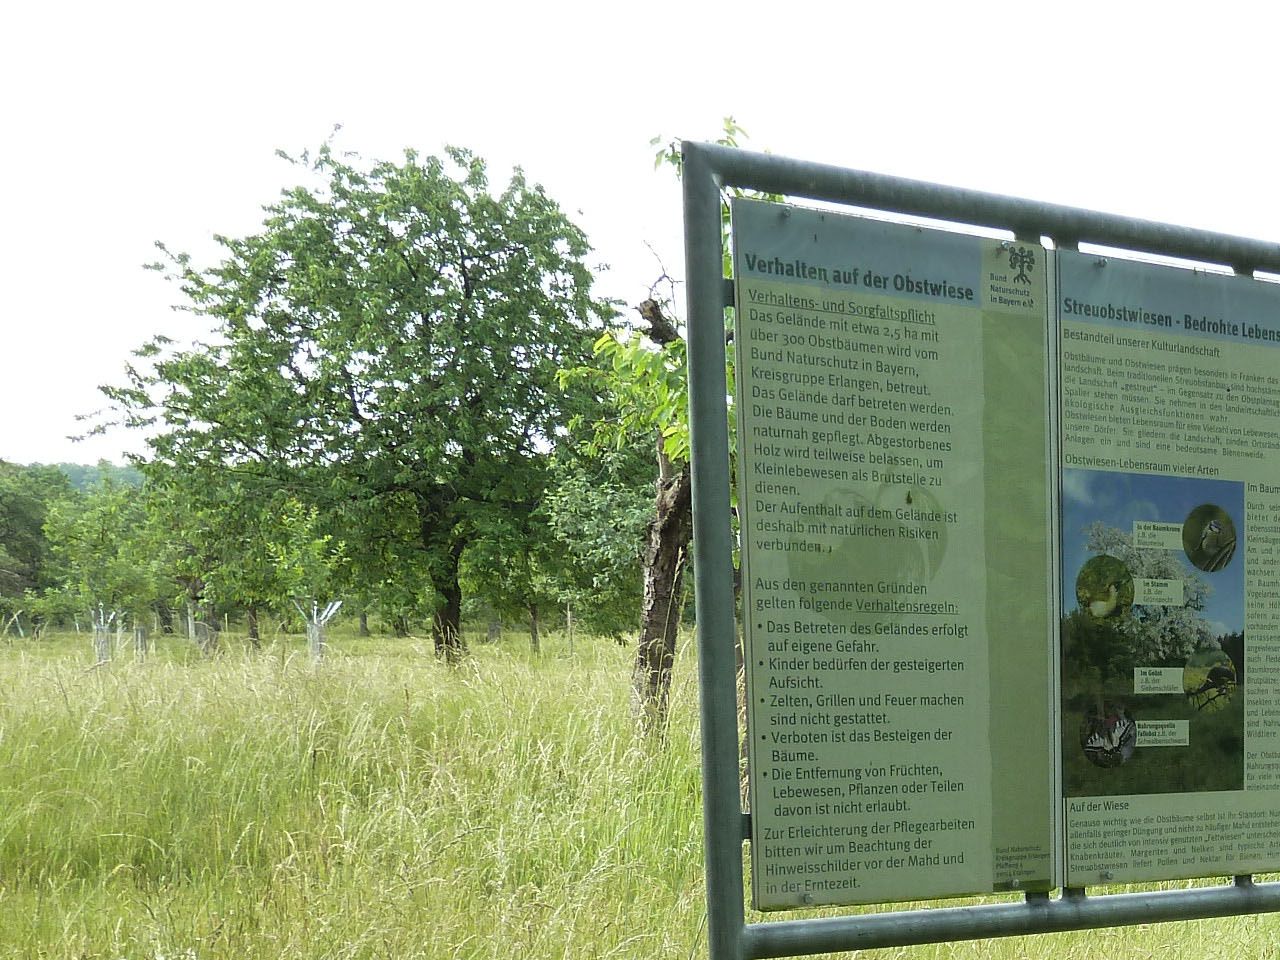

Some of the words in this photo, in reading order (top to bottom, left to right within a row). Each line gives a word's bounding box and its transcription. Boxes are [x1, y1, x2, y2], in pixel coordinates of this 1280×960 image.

[745, 254, 829, 282] Verhalten
[833, 268, 859, 285] auf
[863, 270, 889, 289] der
[893, 275, 974, 300] Obstwiese
[748, 289, 819, 311] Verhaltens-
[822, 300, 845, 314] und
[848, 302, 935, 325] Sorgfaltspflicht
[1064, 298, 1172, 326] Streuobstwiesen
[1184, 315, 1239, 336] Bedrohte
[749, 308, 773, 323] Das
[776, 312, 826, 329] Gelände
[829, 318, 848, 332] mit
[851, 322, 879, 335] etwa
[902, 326, 918, 340] ha
[921, 330, 939, 343] mit
[750, 328, 779, 342] über
[782, 334, 805, 346] 300
[808, 335, 884, 353] Obstbäumen
[886, 344, 911, 357] wird
[914, 349, 938, 360] vom
[1064, 329, 1114, 344] Bestandteil
[1116, 337, 1150, 348] unserer
[1151, 340, 1220, 357] Kulturlandschaft
[751, 347, 783, 362] Bund
[787, 351, 859, 370] Naturschutz
[862, 358, 872, 372] in
[876, 360, 919, 378] Bayern,
[751, 367, 825, 386] Kreisgruppe
[828, 374, 883, 392] Erlangen,
[886, 380, 931, 395] betreut.
[752, 385, 775, 399] Das
[778, 388, 828, 404] Gelände
[831, 393, 856, 407] darf
[858, 395, 907, 411] betreten
[753, 404, 773, 418] Die
[776, 407, 818, 422] Bäume
[822, 412, 844, 424] und
[848, 413, 867, 426] der
[870, 415, 906, 429] Boden
[909, 420, 951, 433] werden
[753, 426, 808, 440] naturnah
[867, 433, 952, 451] Abgestorbenes
[754, 443, 781, 457] Holz
[783, 446, 810, 459] wird
[813, 448, 865, 463] teilweise
[869, 452, 923, 468] belassen,
[926, 459, 943, 469] um
[1065, 454, 1171, 471] Obstwiesen-Lebensraum
[1172, 463, 1196, 474] vieler
[1197, 465, 1219, 476] Arten
[754, 462, 850, 480] Kleinlebewesen
[852, 469, 868, 481] als
[872, 470, 926, 486] Brutstelle
[929, 477, 942, 486] zu
[755, 481, 800, 495] dienen.
[1248, 480, 1258, 492] Im
[756, 500, 777, 513] Der
[780, 502, 842, 517] Aufenthalt
[845, 504, 866, 518] auf
[867, 506, 894, 520] dem
[895, 508, 941, 522] Gelände
[943, 512, 957, 523] ist
[756, 518, 804, 532] deshalb
[808, 521, 827, 534] mit
[830, 524, 895, 537] natürlichen
[898, 525, 938, 540] Risiken
[755, 577, 779, 590] Aus
[782, 578, 806, 592] den
[809, 582, 874, 596] genannten
[877, 580, 927, 595] Gründen
[756, 596, 795, 611] gelten
[799, 595, 853, 613] folgende
[856, 599, 958, 615] Verhaltensregeln:
[767, 620, 790, 633] Das
[794, 621, 846, 634] Betreten
[850, 621, 873, 635] des
[874, 622, 929, 635] Geländes
[932, 623, 968, 638] erfolgt
[768, 639, 789, 652] auf
[791, 640, 832, 655] eigene
[836, 640, 879, 653] Gefahr.
[769, 657, 809, 670] Kinder
[812, 658, 867, 671] bedürfen
[870, 658, 890, 671] der
[893, 659, 964, 673] gesteigerten
[769, 676, 823, 689] Aufsicht.
[770, 694, 812, 708] Zelten,
[816, 694, 855, 707] Grillen
[859, 694, 881, 706] und
[885, 694, 917, 706] Feuer
[920, 694, 964, 706] machen
[770, 712, 796, 726] sind
[800, 712, 830, 725] nicht
[833, 713, 890, 727] gestattet.
[771, 731, 828, 744] Verboten
[831, 730, 846, 743] ist
[849, 729, 870, 742] das
[874, 729, 930, 743] Besteigen
[934, 728, 952, 741] der
[772, 750, 819, 762] Bäume.
[772, 768, 792, 780] Die
[796, 767, 862, 782] Entfernung
[864, 768, 886, 777] von
[890, 764, 943, 779] Früchten,
[773, 786, 845, 800] Lebewesen,
[849, 783, 898, 795] Pflanzen
[901, 781, 928, 793] oder
[930, 780, 964, 792] Teilen
[774, 804, 812, 816] davon
[815, 802, 831, 815] ist
[833, 801, 863, 814] nicht
[866, 799, 910, 812] erlaubt.
[1069, 802, 1085, 812] Auf
[1086, 800, 1102, 811] der
[1103, 801, 1129, 811] Wiese
[764, 828, 785, 840] Zur
[788, 825, 868, 838] Erleichterung
[871, 821, 891, 834] der
[893, 819, 975, 834] Pflegearbeiten
[765, 845, 801, 858] bitten
[804, 843, 825, 856] wir
[826, 845, 845, 855] um
[848, 836, 910, 853] Beachtung
[914, 837, 932, 849] der
[766, 859, 862, 876] Hinweisschilder
[864, 860, 883, 870] vor
[886, 856, 905, 868] der
[908, 853, 940, 867] Mahd
[943, 852, 964, 865] und
[766, 882, 777, 894] in
[781, 880, 801, 893] der
[805, 877, 861, 891] Erntezeit.
